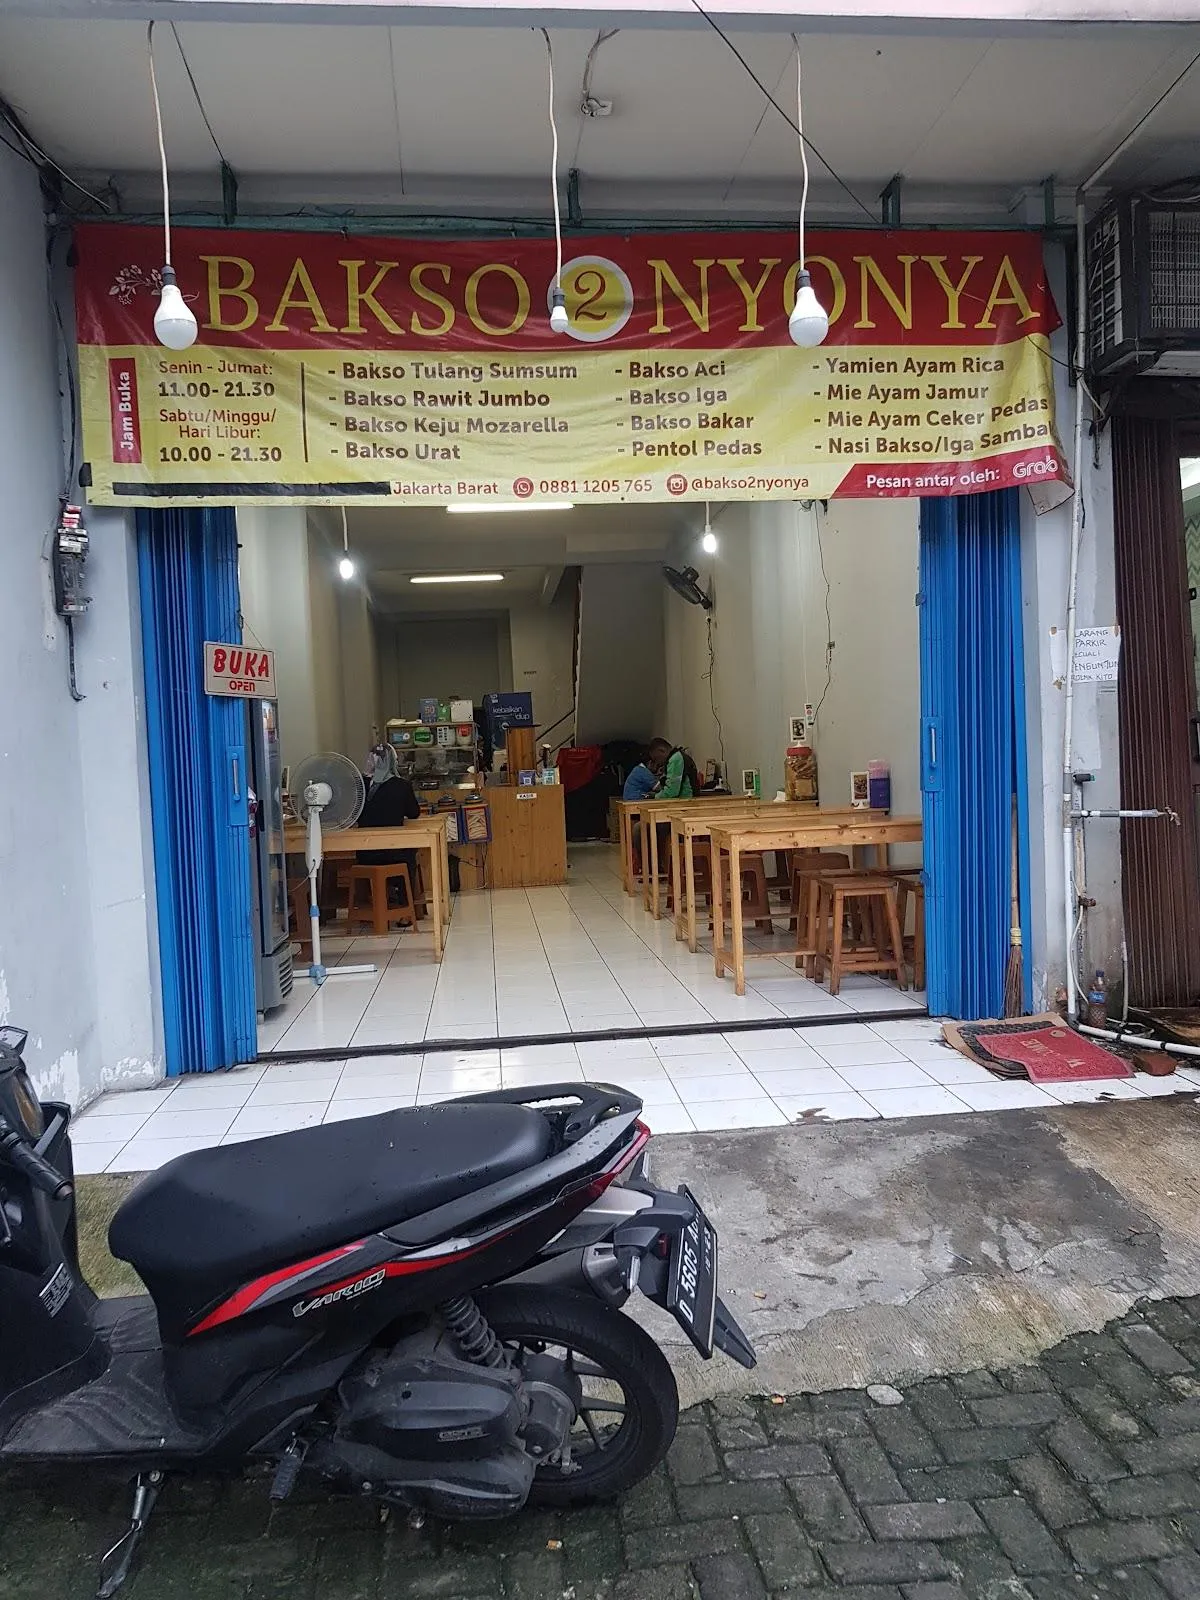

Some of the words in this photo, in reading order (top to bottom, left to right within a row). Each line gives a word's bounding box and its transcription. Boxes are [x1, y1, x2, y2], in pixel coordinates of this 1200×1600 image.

[199, 255, 531, 336] BAKSO
[573, 270, 608, 322] 2
[647, 255, 1040, 333] NYONYA
[159, 361, 202, 374] Senin
[217, 360, 273, 375] Jumat:
[342, 362, 406, 379] Bakso
[411, 362, 483, 382] Tulang
[489, 362, 578, 379] Sumsum
[629, 361, 689, 378] Bakso
[694, 360, 726, 377] Aci
[825, 357, 898, 374] Yamien
[903, 357, 956, 378] Ayam
[962, 356, 1005, 373] Rica
[118, 370, 133, 410] Buka
[224, 382, 275, 397] 21.30
[343, 390, 407, 407] Bakso
[413, 390, 473, 407] Rawit
[478, 390, 550, 407] Jumbo
[630, 389, 690, 406] Bakso
[697, 388, 728, 406] Iga
[827, 384, 861, 400] Mie
[867, 384, 920, 403] Ayam
[925, 383, 989, 400] Jamur
[159, 408, 277, 425] Sabtu/Minggu/
[631, 415, 692, 431] Bakso
[698, 413, 754, 430] Bakar
[828, 411, 862, 427] Mie
[868, 411, 920, 430] Ayam
[926, 410, 985, 427] Ceker
[991, 396, 1049, 422] Pedas
[119, 412, 135, 450] Jam
[179, 425, 210, 439] Hari
[216, 425, 260, 439] Libur:
[344, 416, 408, 433] Bakso
[414, 417, 461, 436] Keju
[466, 416, 569, 433] Mozarella
[160, 447, 215, 462] 10.00
[230, 446, 282, 462] 21.30
[346, 442, 409, 459] Bakso
[415, 443, 461, 460] Urat
[632, 440, 698, 457] Pentol
[704, 440, 762, 456] Pedas
[828, 437, 870, 454] Nasi
[876, 435, 974, 457] Bakso/Iga
[1012, 455, 1058, 479] Grab
[540, 480, 578, 494] 0881
[584, 479, 619, 493] 1205
[624, 479, 653, 493] 765
[691, 474, 809, 490] @bakso2nyonya
[866, 474, 910, 489] Pesan
[915, 474, 956, 488] antar
[960, 468, 1000, 485] oleh:
[393, 481, 452, 496] Jakarta
[457, 481, 498, 495] Barat
[1075, 638, 1107, 648] PARKIR
[213, 648, 270, 678] BUKA
[229, 680, 256, 692] OPEN
[680, 1241, 698, 1299] 5605
[291, 1268, 386, 1317] VARIO
[679, 1299, 694, 1324] D
